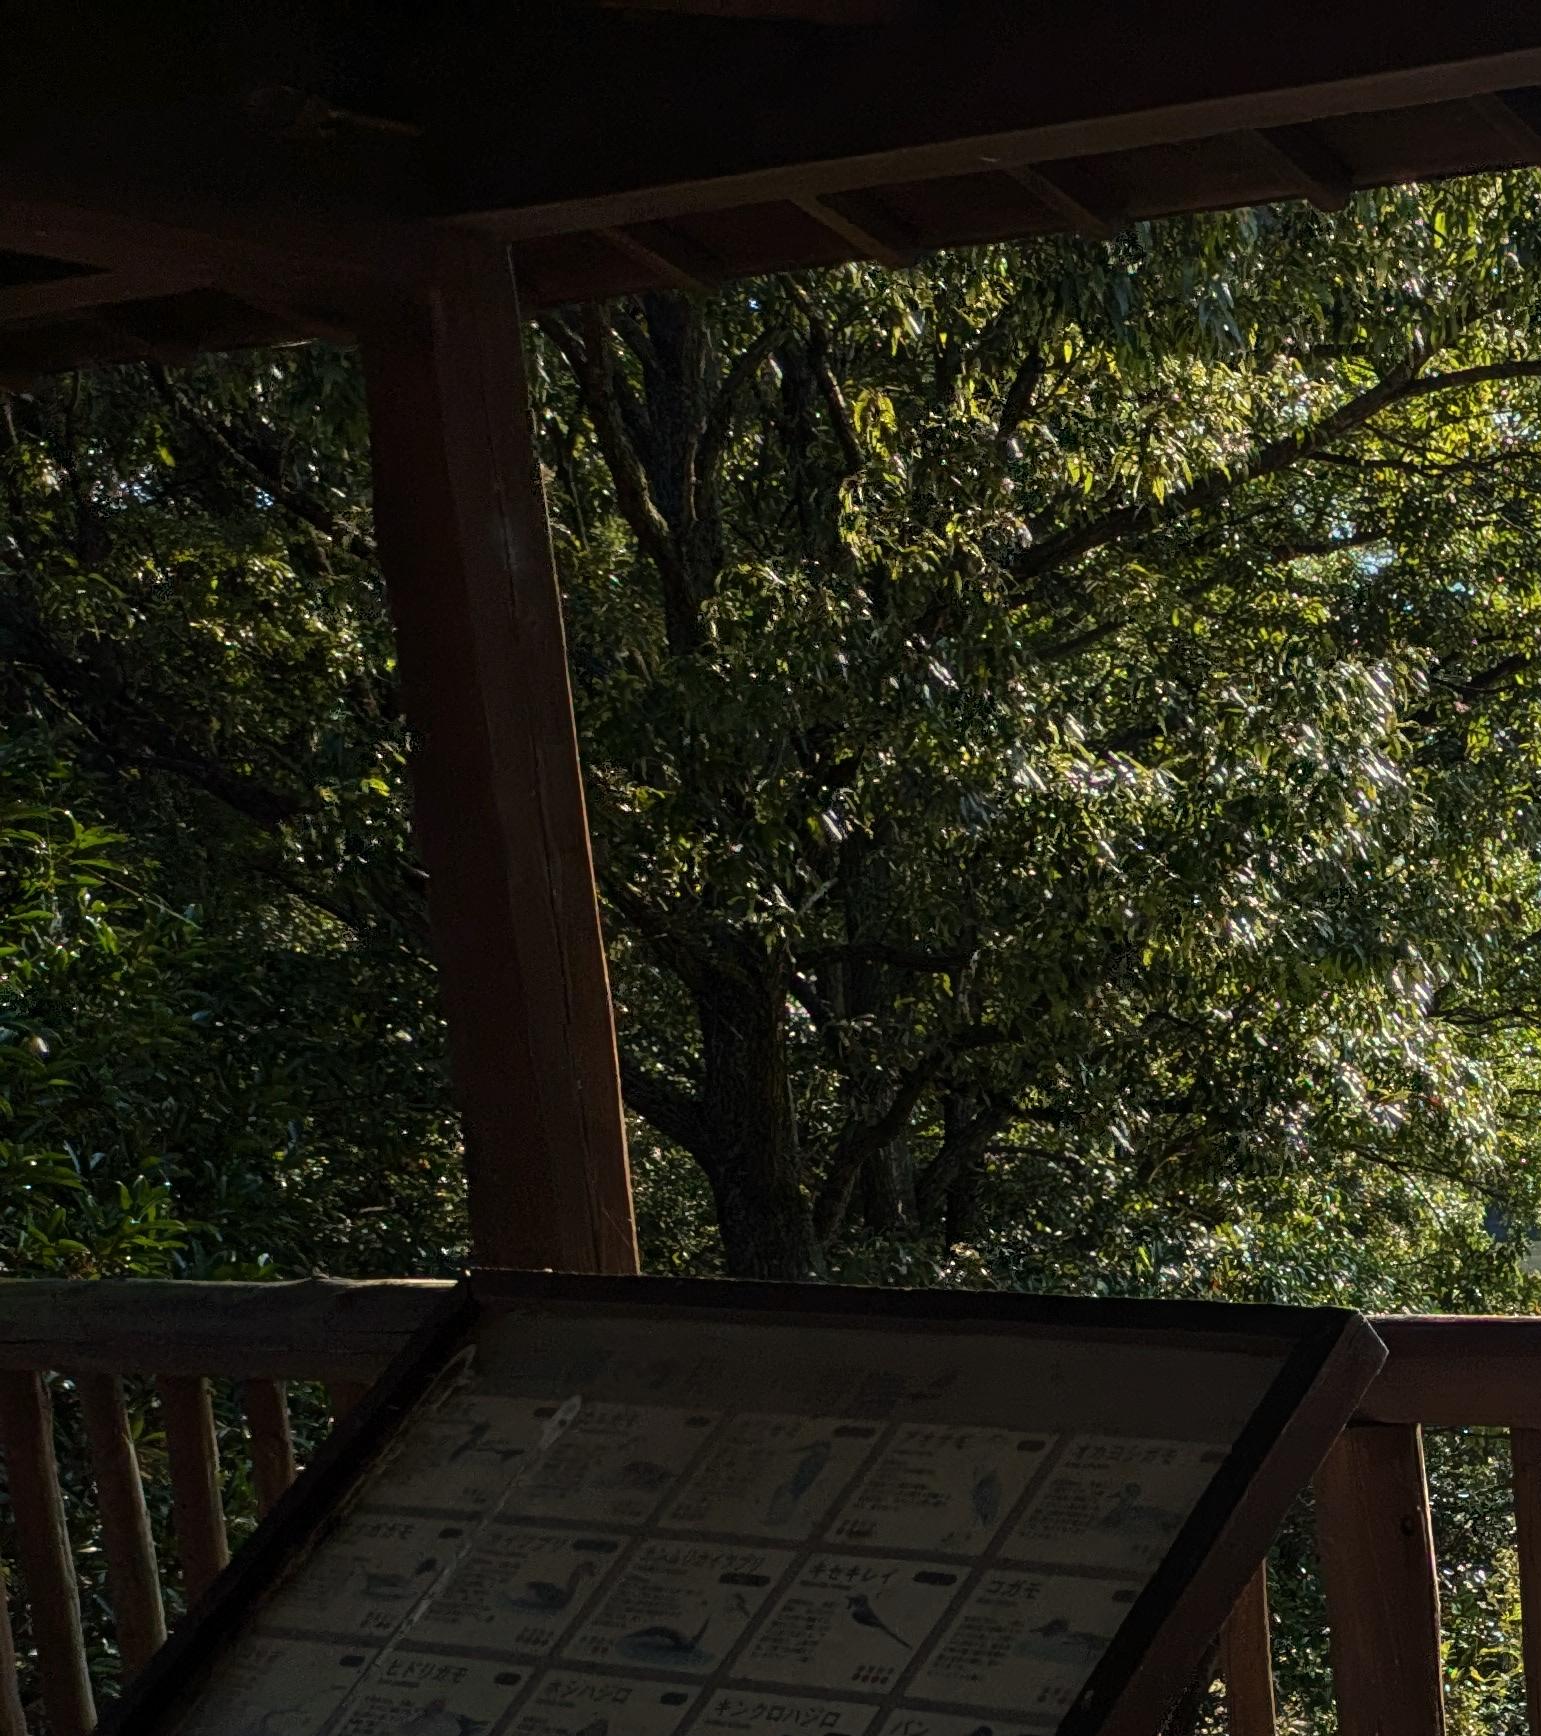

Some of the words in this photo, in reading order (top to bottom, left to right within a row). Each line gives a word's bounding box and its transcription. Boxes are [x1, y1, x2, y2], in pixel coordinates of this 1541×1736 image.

[809, 1562, 900, 1585] キセキレイ
[985, 1580, 1043, 1600] コガモ
[386, 1659, 469, 1684] ヒドリガモ
[714, 1699, 842, 1728] キンクロハジロ
